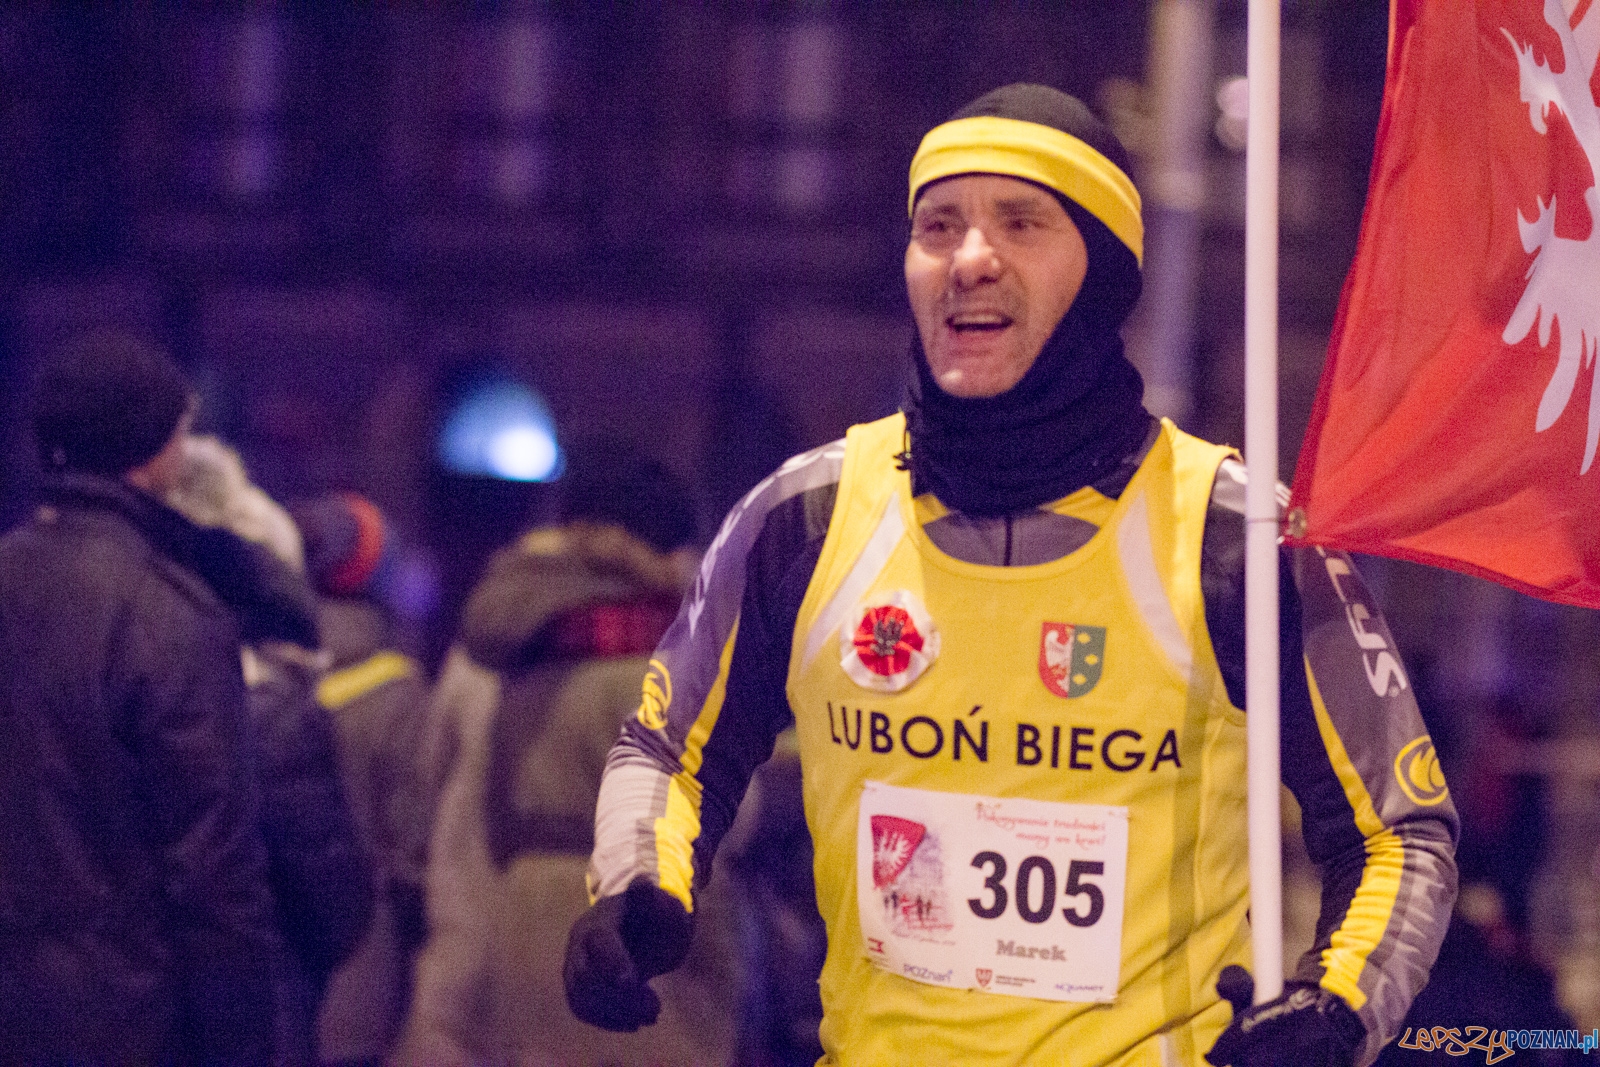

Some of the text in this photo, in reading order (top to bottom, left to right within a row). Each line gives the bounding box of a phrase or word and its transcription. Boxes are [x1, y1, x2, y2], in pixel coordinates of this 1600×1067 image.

[827, 702, 1182, 772] LUBOŃ BIEGA
[967, 850, 1105, 928] 305
[996, 939, 1067, 962] Marek
